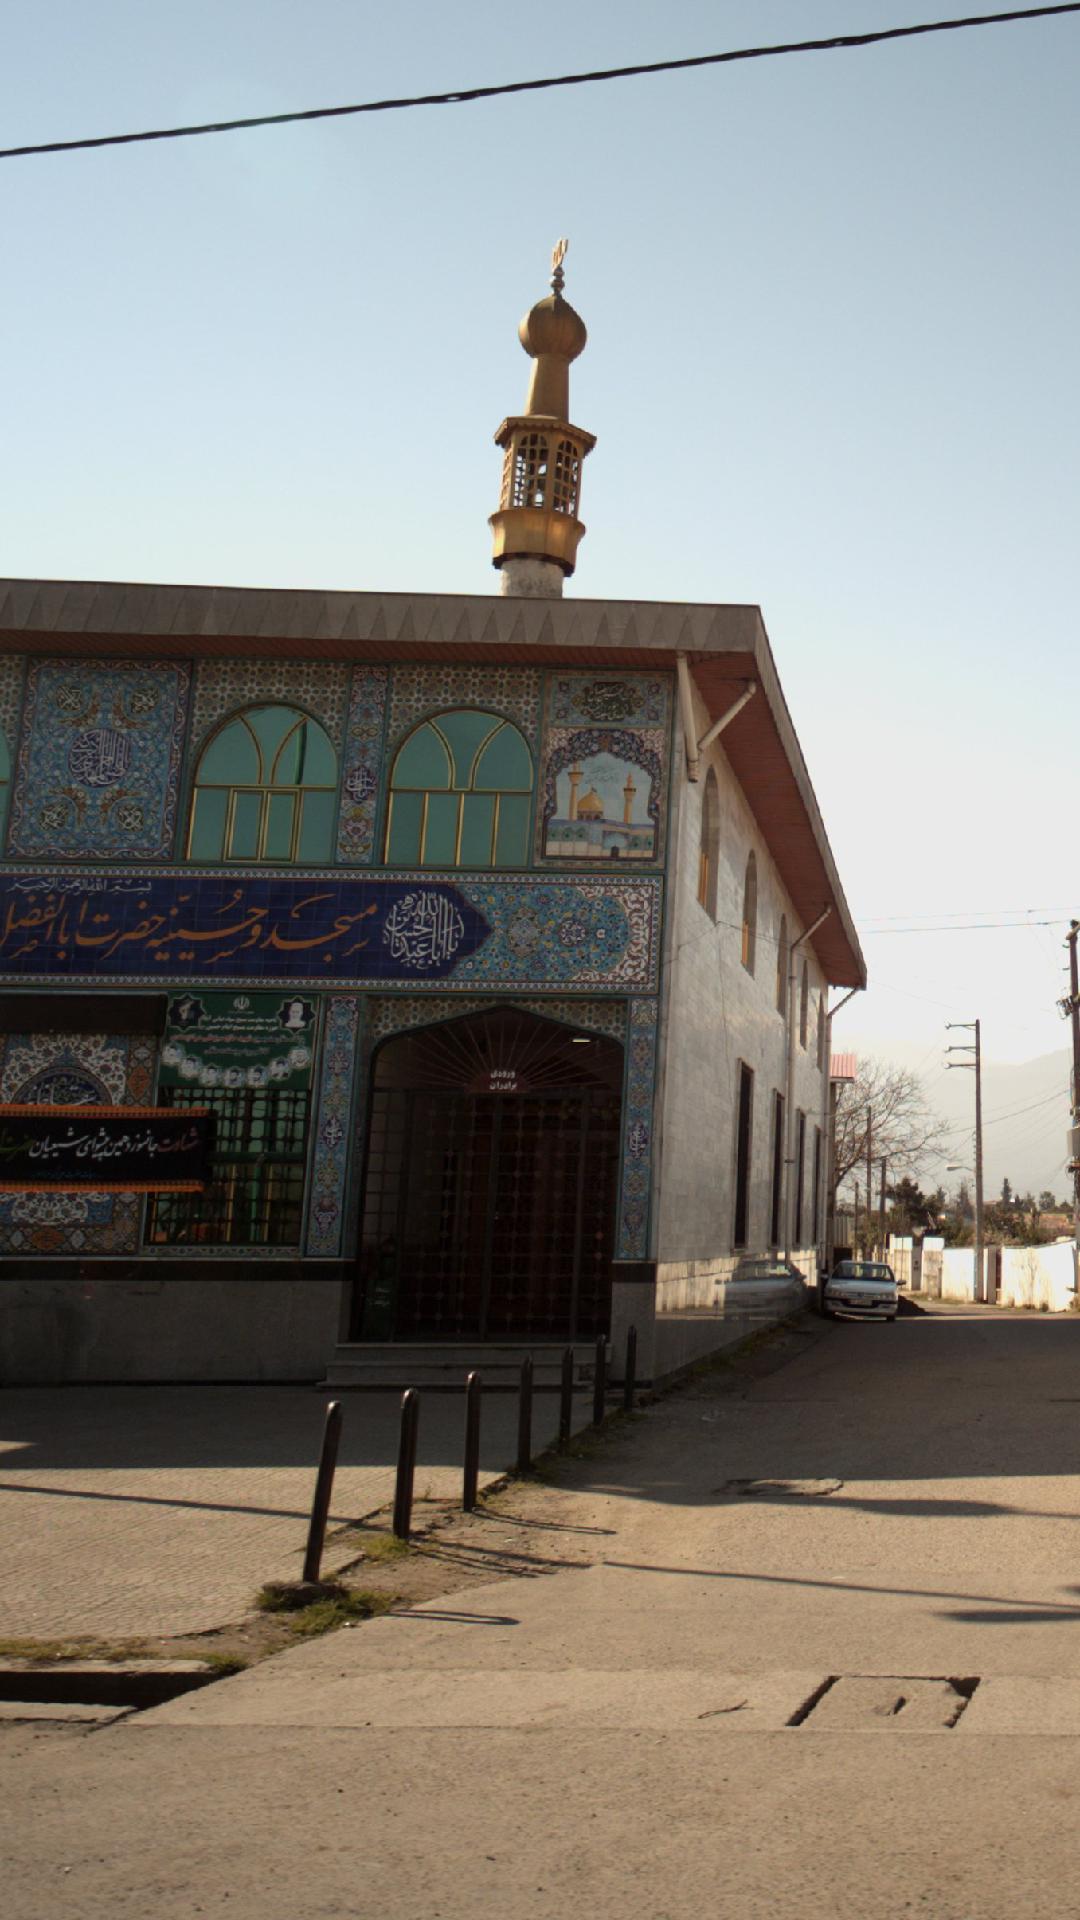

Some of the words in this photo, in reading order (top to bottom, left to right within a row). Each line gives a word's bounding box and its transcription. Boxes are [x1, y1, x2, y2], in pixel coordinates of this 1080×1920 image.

[75, 900, 168, 961] حضرت
[259, 894, 379, 964] مسجد
[489, 1081, 518, 1090] برادران
[490, 1069, 516, 1079] ورودی
